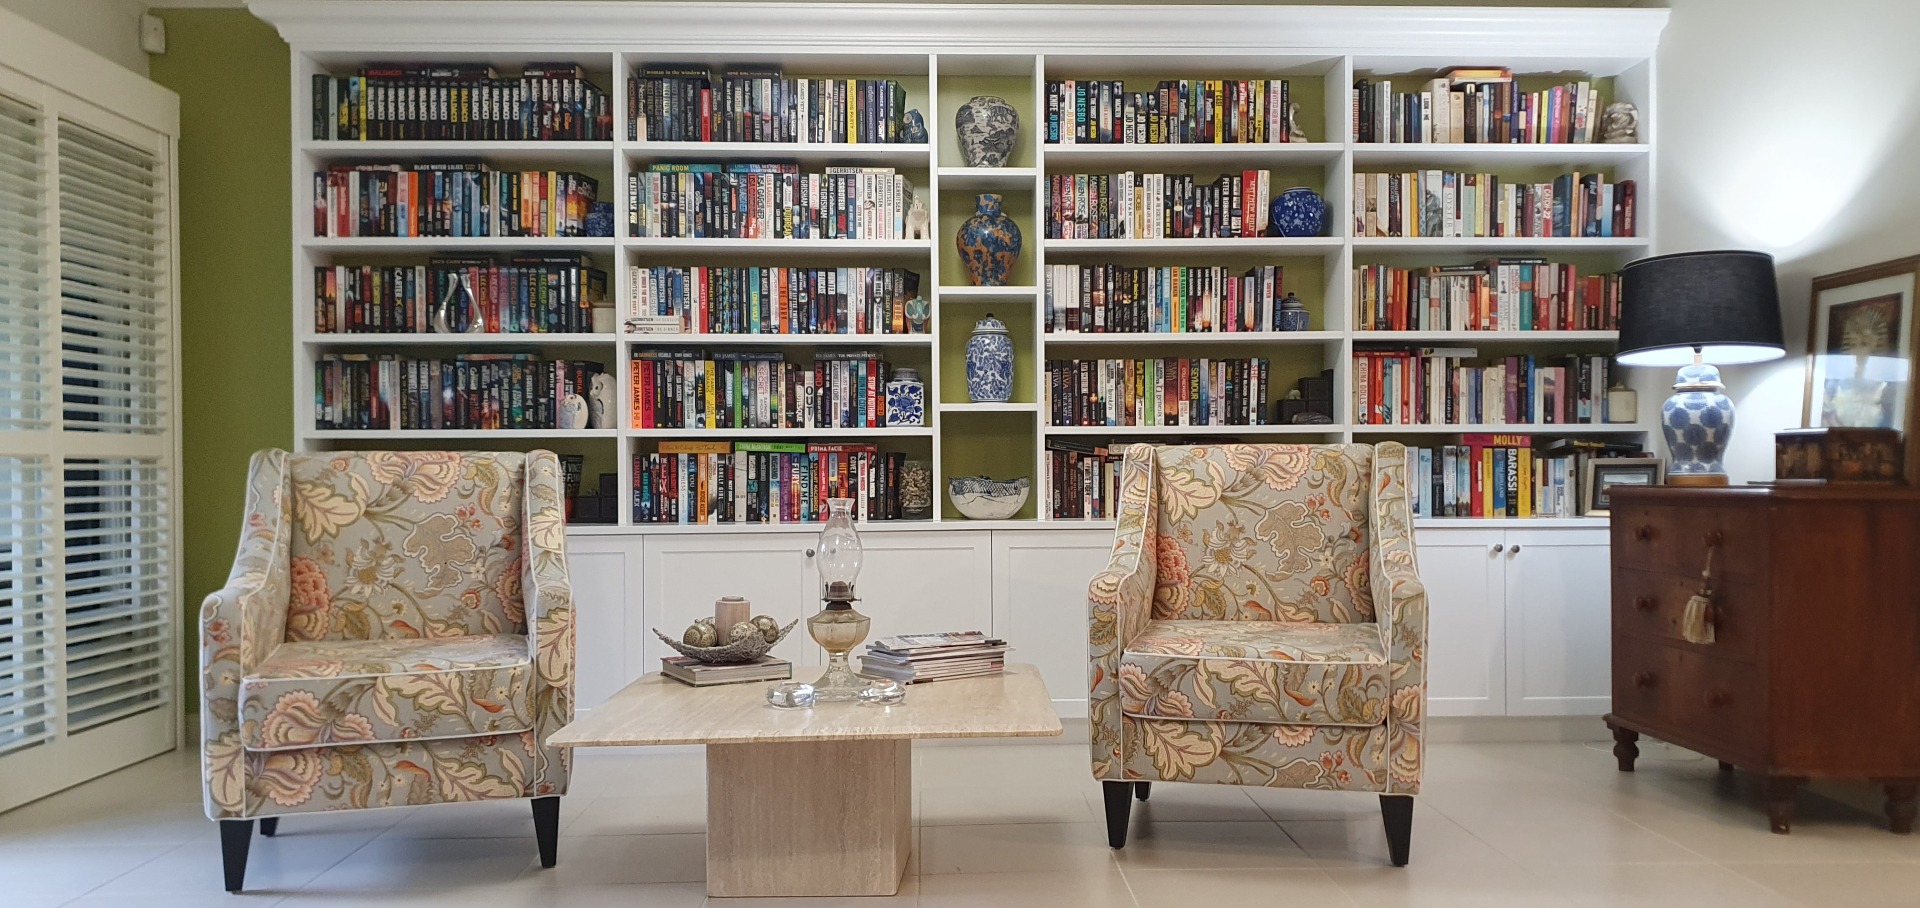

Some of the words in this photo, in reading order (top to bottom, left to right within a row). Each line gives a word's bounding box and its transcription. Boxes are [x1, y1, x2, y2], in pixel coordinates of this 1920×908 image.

[1078, 86, 1085, 96] JO
[1125, 115, 1133, 123] JO
[1137, 115, 1145, 123] JO
[1494, 434, 1521, 446] MOLLY
[1508, 449, 1517, 490] BARASSI
[801, 491, 808, 504] ME
